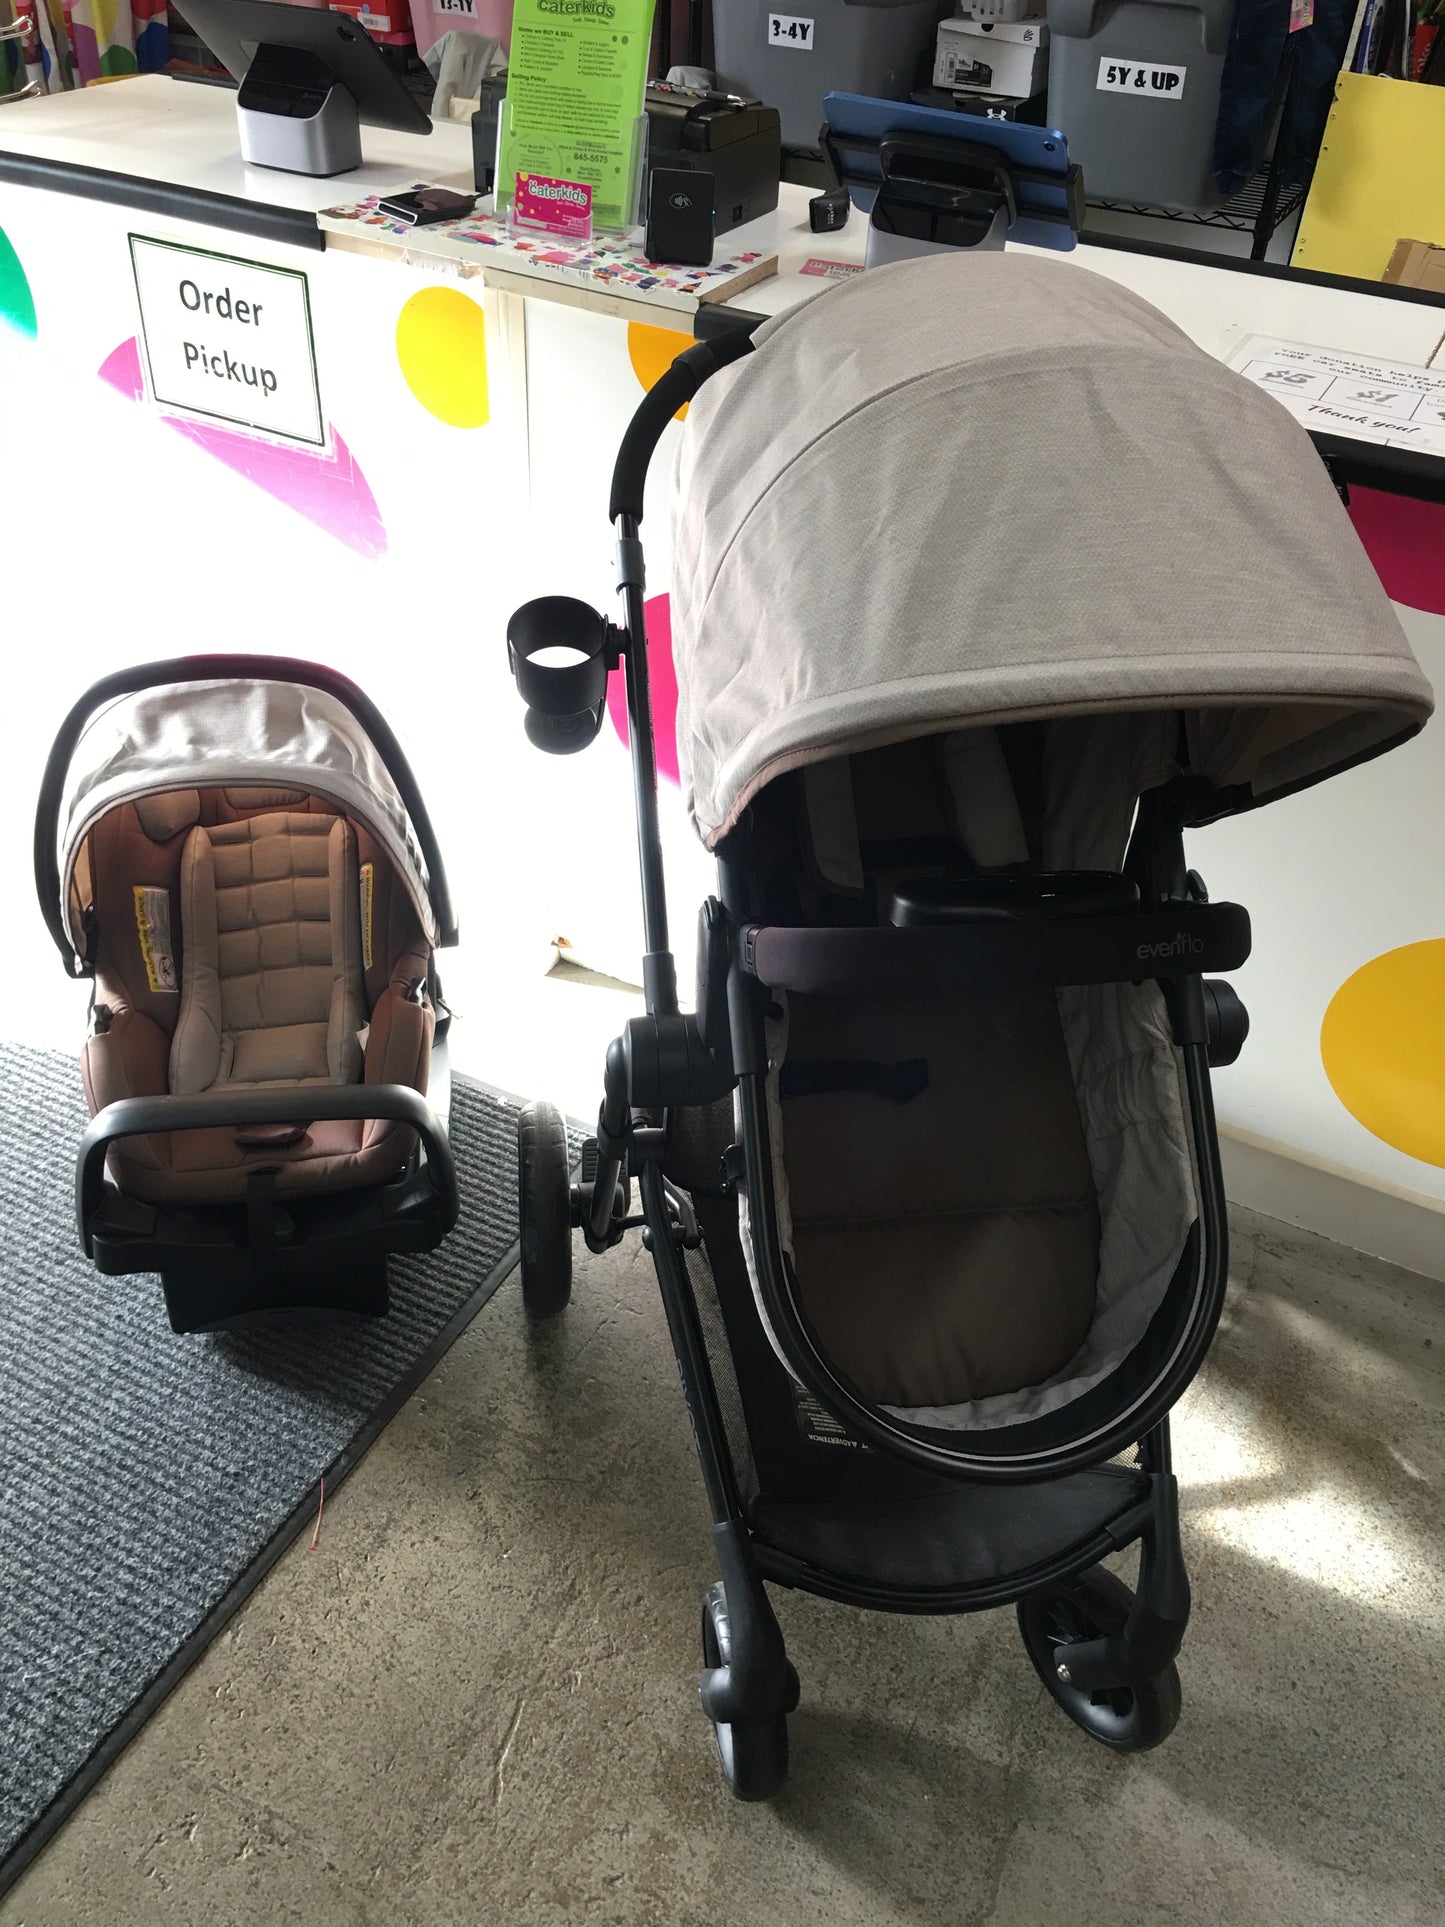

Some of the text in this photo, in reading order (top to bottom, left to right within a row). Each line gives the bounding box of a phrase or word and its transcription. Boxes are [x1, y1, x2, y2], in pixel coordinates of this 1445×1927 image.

[772, 20, 811, 41] 3-4Y
[511, 72, 546, 83] Selling Policy
[1107, 65, 1180, 91] 5Y & UP
[179, 280, 264, 327] Order
[183, 341, 279, 397] Pickup
[1274, 351, 1305, 361] FREE
[1312, 359, 1337, 367] car
[1344, 366, 1382, 378] seats
[1282, 348, 1430, 381] Your donation helps
[1328, 367, 1352, 375] our
[1356, 390, 1399, 403] $1
[1307, 404, 1421, 434] Thank you!
[1137, 933, 1204, 959] evenflo
